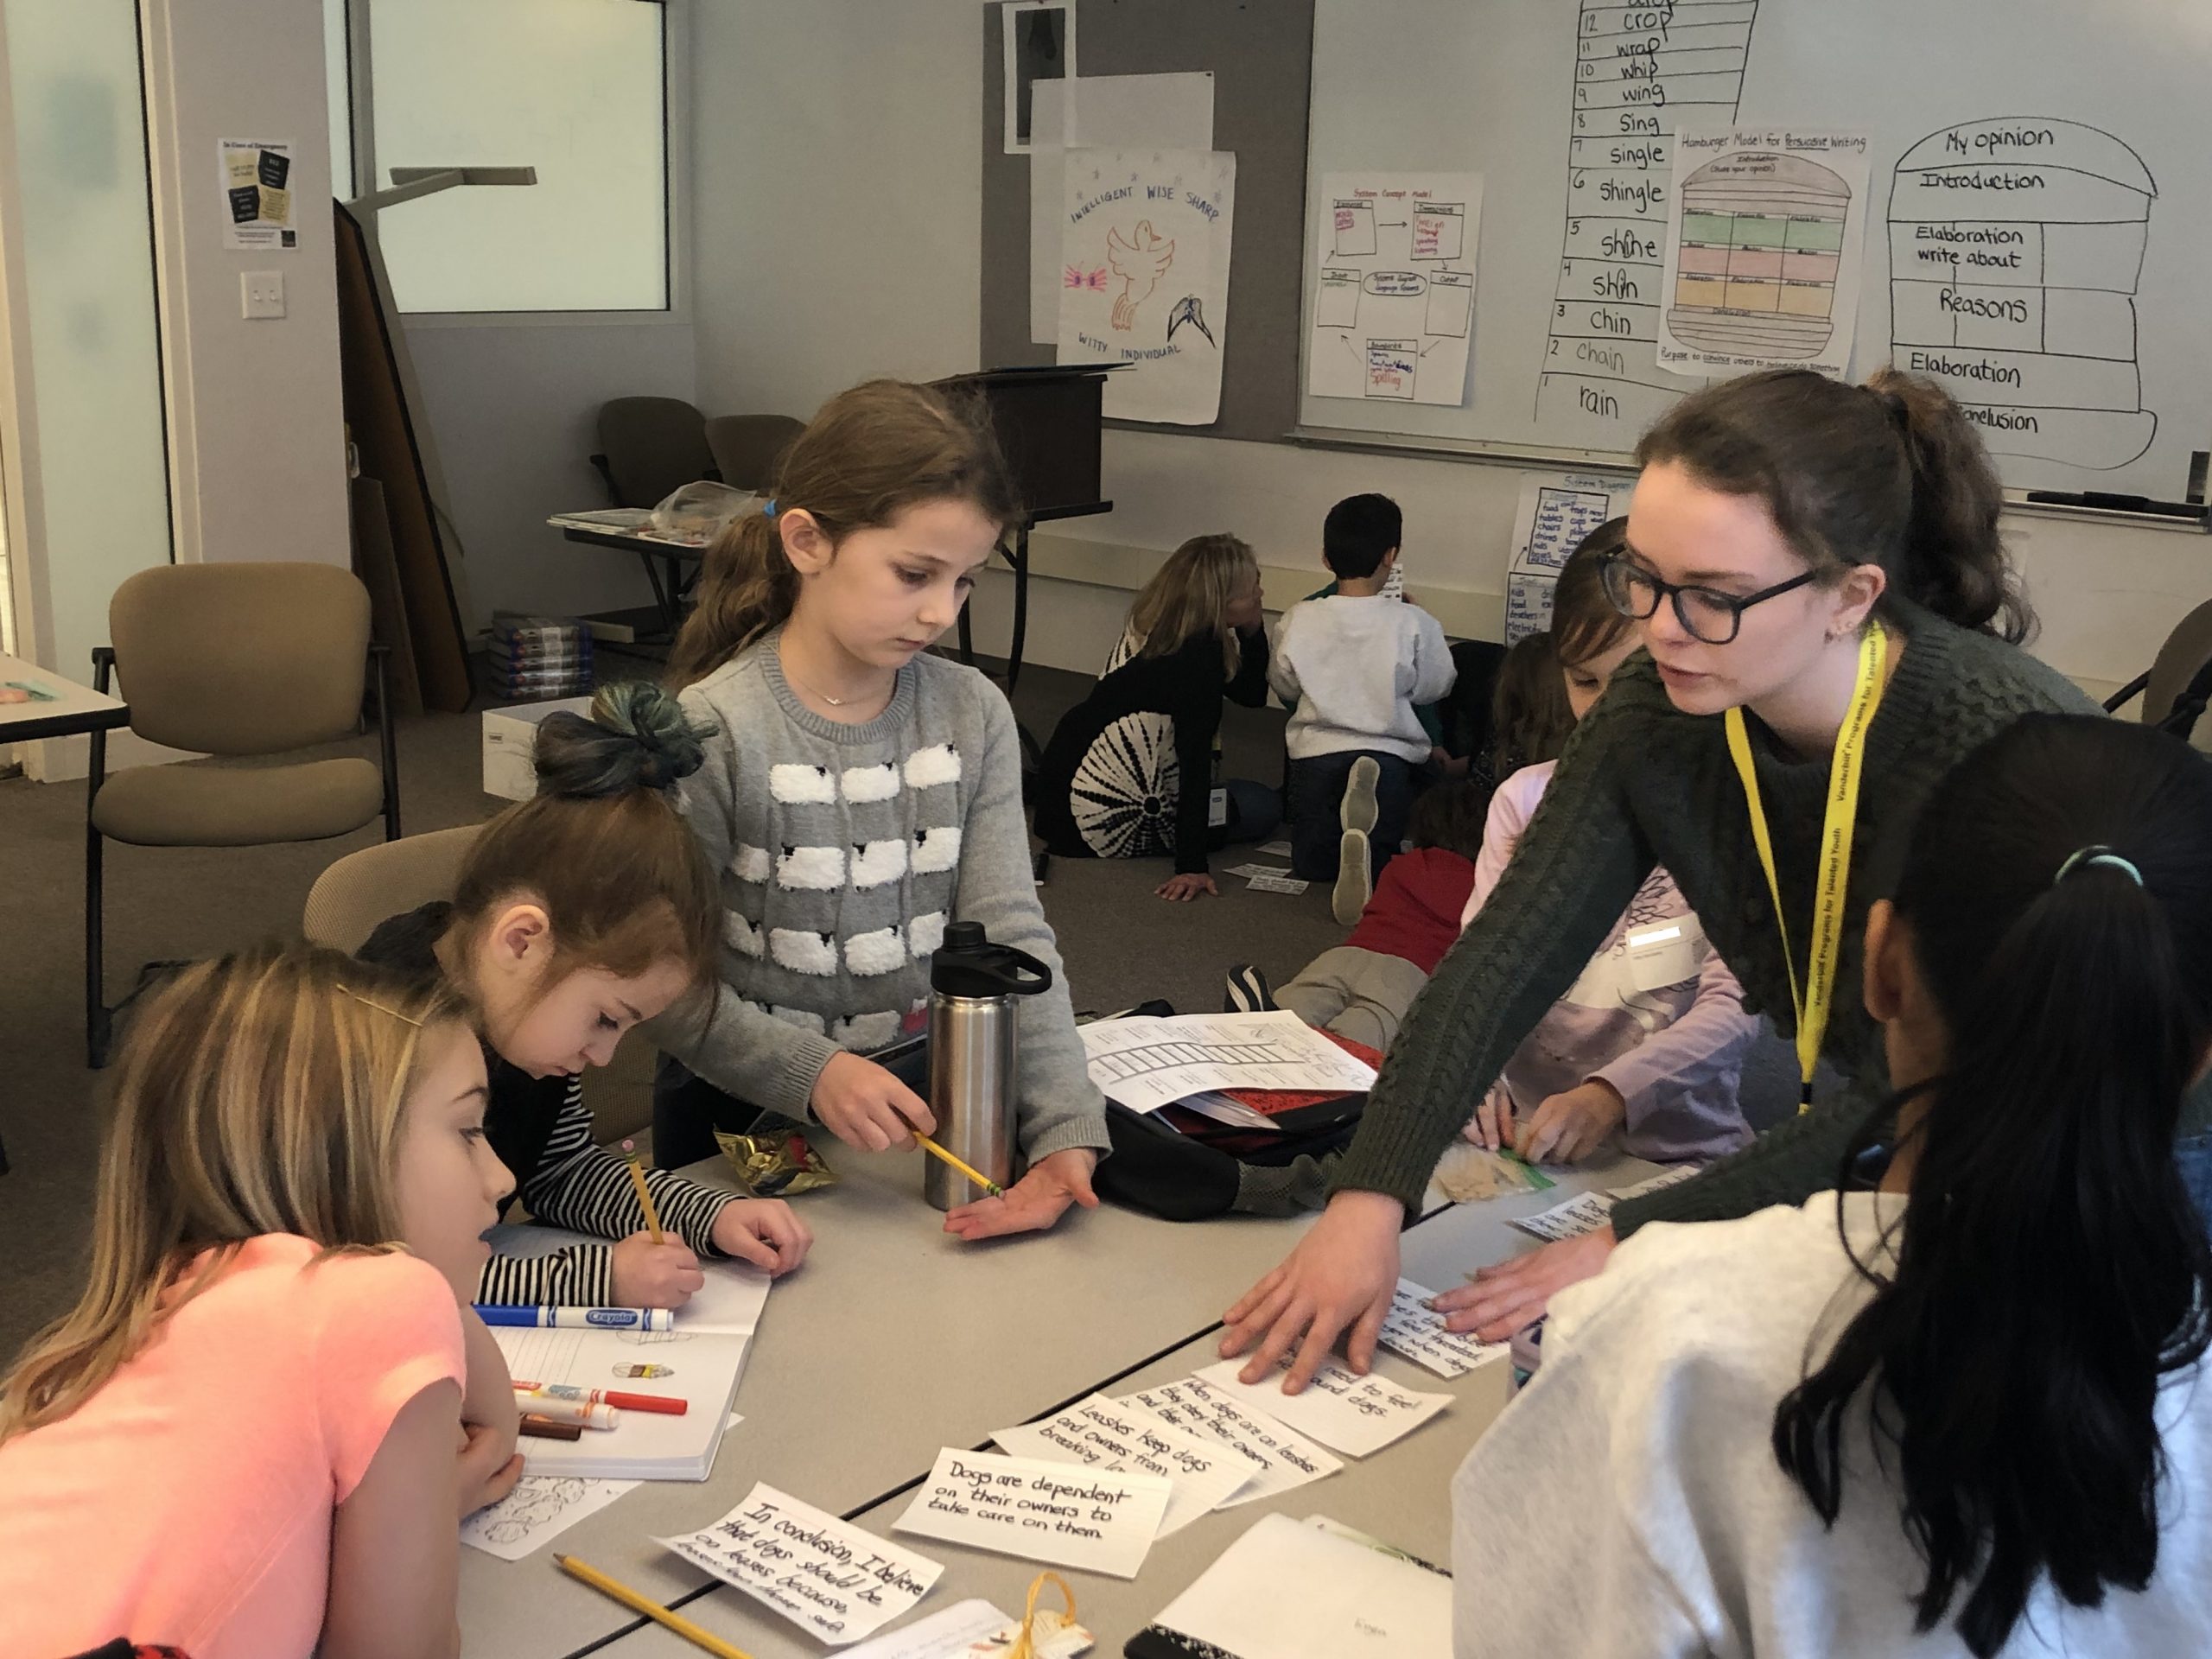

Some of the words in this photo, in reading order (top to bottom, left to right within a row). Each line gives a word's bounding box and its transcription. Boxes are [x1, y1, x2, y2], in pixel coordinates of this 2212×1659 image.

[1585, 11, 1597, 32] 12
[1624, 11, 1672, 42] crop
[1581, 41, 1591, 53] 11
[1617, 37, 1660, 63] wrap
[1580, 63, 1594, 78] 10
[1621, 59, 1658, 83] whip
[1578, 88, 1587, 103] 9
[1622, 84, 1666, 107] wing
[1577, 113, 1586, 129] 8
[1573, 139, 1582, 152] 7
[1611, 143, 1665, 170] single
[1681, 134, 1729, 153] Hamburger
[1733, 133, 1762, 146] Model
[1785, 132, 1827, 148] Persuasive
[1830, 133, 1866, 154] Writing
[1946, 131, 1967, 156] My
[1974, 129, 2054, 156] opinion
[1573, 169, 1585, 189] 6
[1919, 171, 2044, 190] Introduction
[1071, 185, 1135, 224] INTELLIGENT
[1147, 186, 1174, 201] WISE
[1185, 191, 1220, 222] SHARP
[1570, 221, 1580, 235] 5
[1601, 229, 1658, 258] shine
[1916, 226, 2024, 245] Elaboration
[1917, 248, 1960, 265] write
[1967, 251, 2022, 269] about
[1564, 262, 1571, 276] 4
[1592, 268, 1638, 299] shin
[1556, 305, 1565, 317] 3
[1940, 289, 2027, 323] Reasons
[1078, 331, 1109, 353] WITTY
[1121, 346, 1181, 359] INDIVIDUAL
[1550, 340, 1559, 355] 2
[1661, 346, 1688, 362] Purpose
[1703, 353, 1730, 363] convince
[1910, 352, 2021, 388] Elaboration
[1543, 375, 1548, 387] 1
[1580, 385, 1618, 420] rain
[1962, 407, 2038, 434] onclusion
[1866, 640, 1878, 682] Talented
[1831, 828, 1841, 854] Youth
[590, 1311, 633, 1324] Crayola
[1137, 1394, 1165, 1408] and
[1077, 1402, 1135, 1437] Leashes
[1173, 1449, 1211, 1473] dogs
[1211, 1402, 1243, 1421] dogs
[1239, 1421, 1262, 1435] are
[1259, 1435, 1278, 1447] on
[1039, 1426, 1101, 1464] breaking
[1056, 1416, 1081, 1433] and
[1084, 1431, 1132, 1457] owners
[1133, 1453, 1168, 1477] from
[1207, 1418, 1237, 1440] their
[1233, 1441, 1274, 1470] owners
[950, 1460, 992, 1488] Dogs
[996, 1474, 1023, 1487] are
[1031, 1476, 1132, 1505] dependent
[927, 1499, 969, 1516] take
[977, 1510, 1015, 1524] care
[1022, 1518, 1048, 1530] on
[935, 1486, 957, 1497] on
[970, 1489, 1013, 1507] their
[1017, 1499, 1080, 1517] owners
[1090, 1506, 1112, 1522] to
[696, 1534, 721, 1548] on
[744, 1502, 779, 1523] In
[774, 1519, 854, 1567] conclusion,
[856, 1553, 886, 1573] I
[880, 1556, 925, 1597] believe
[716, 1519, 760, 1541] that
[753, 1537, 794, 1560] dogs
[796, 1560, 860, 1588] should
[855, 1582, 883, 1606] be
